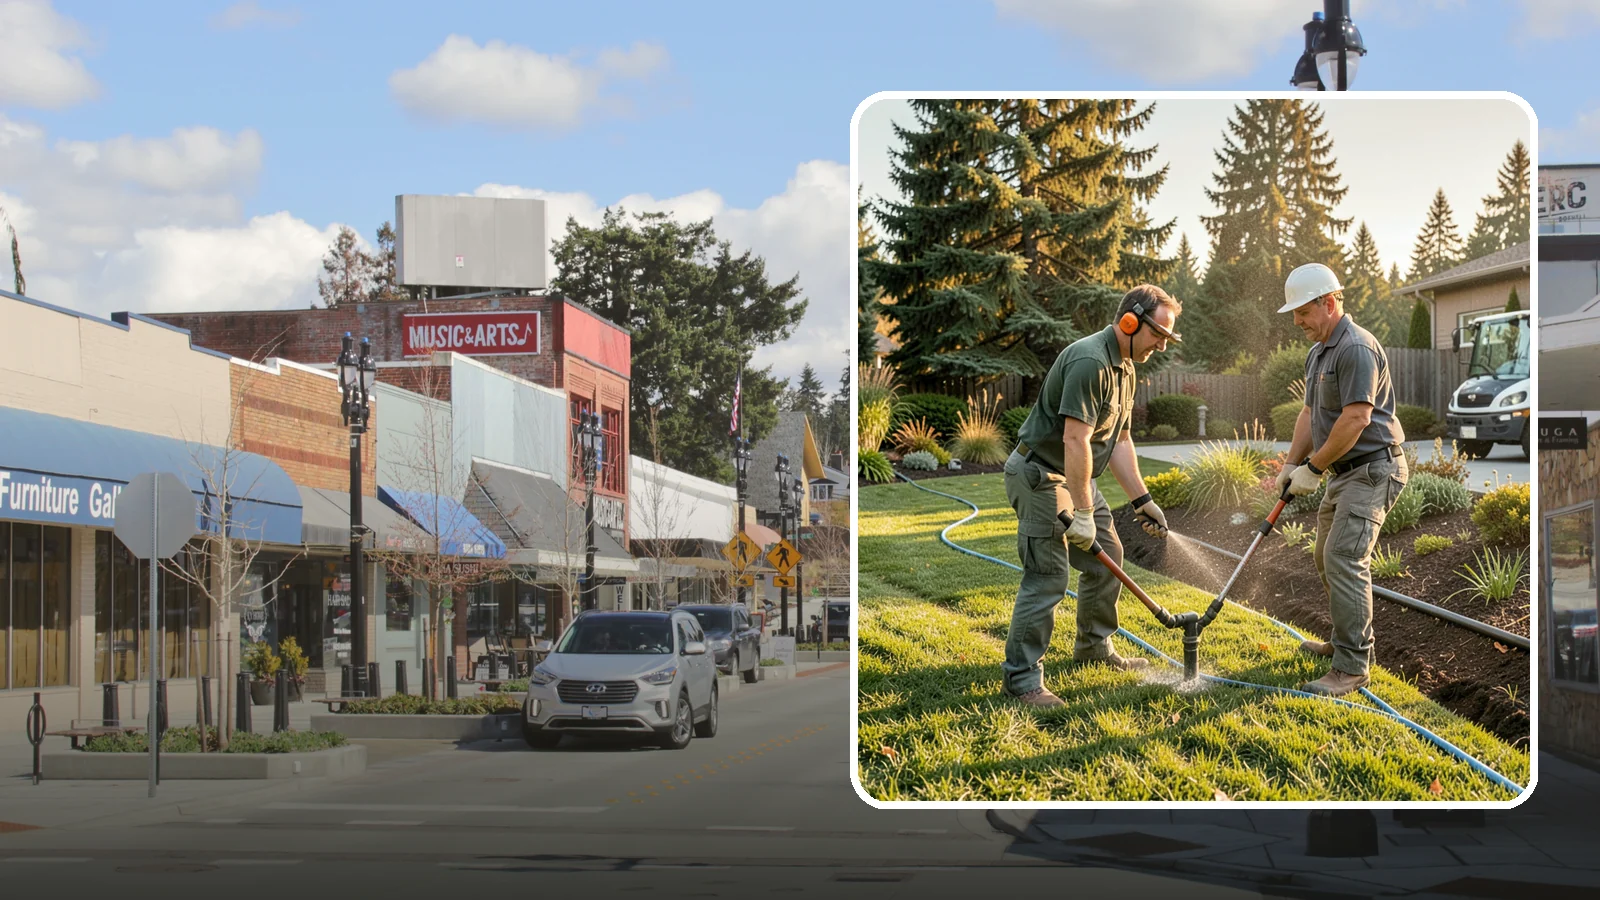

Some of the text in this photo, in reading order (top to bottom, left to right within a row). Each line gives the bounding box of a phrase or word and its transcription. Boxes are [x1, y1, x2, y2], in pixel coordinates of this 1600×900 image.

[1540, 427, 1578, 437] UGA
[0, 471, 79, 515] Furniture
[453, 563, 479, 573] SUSHI
